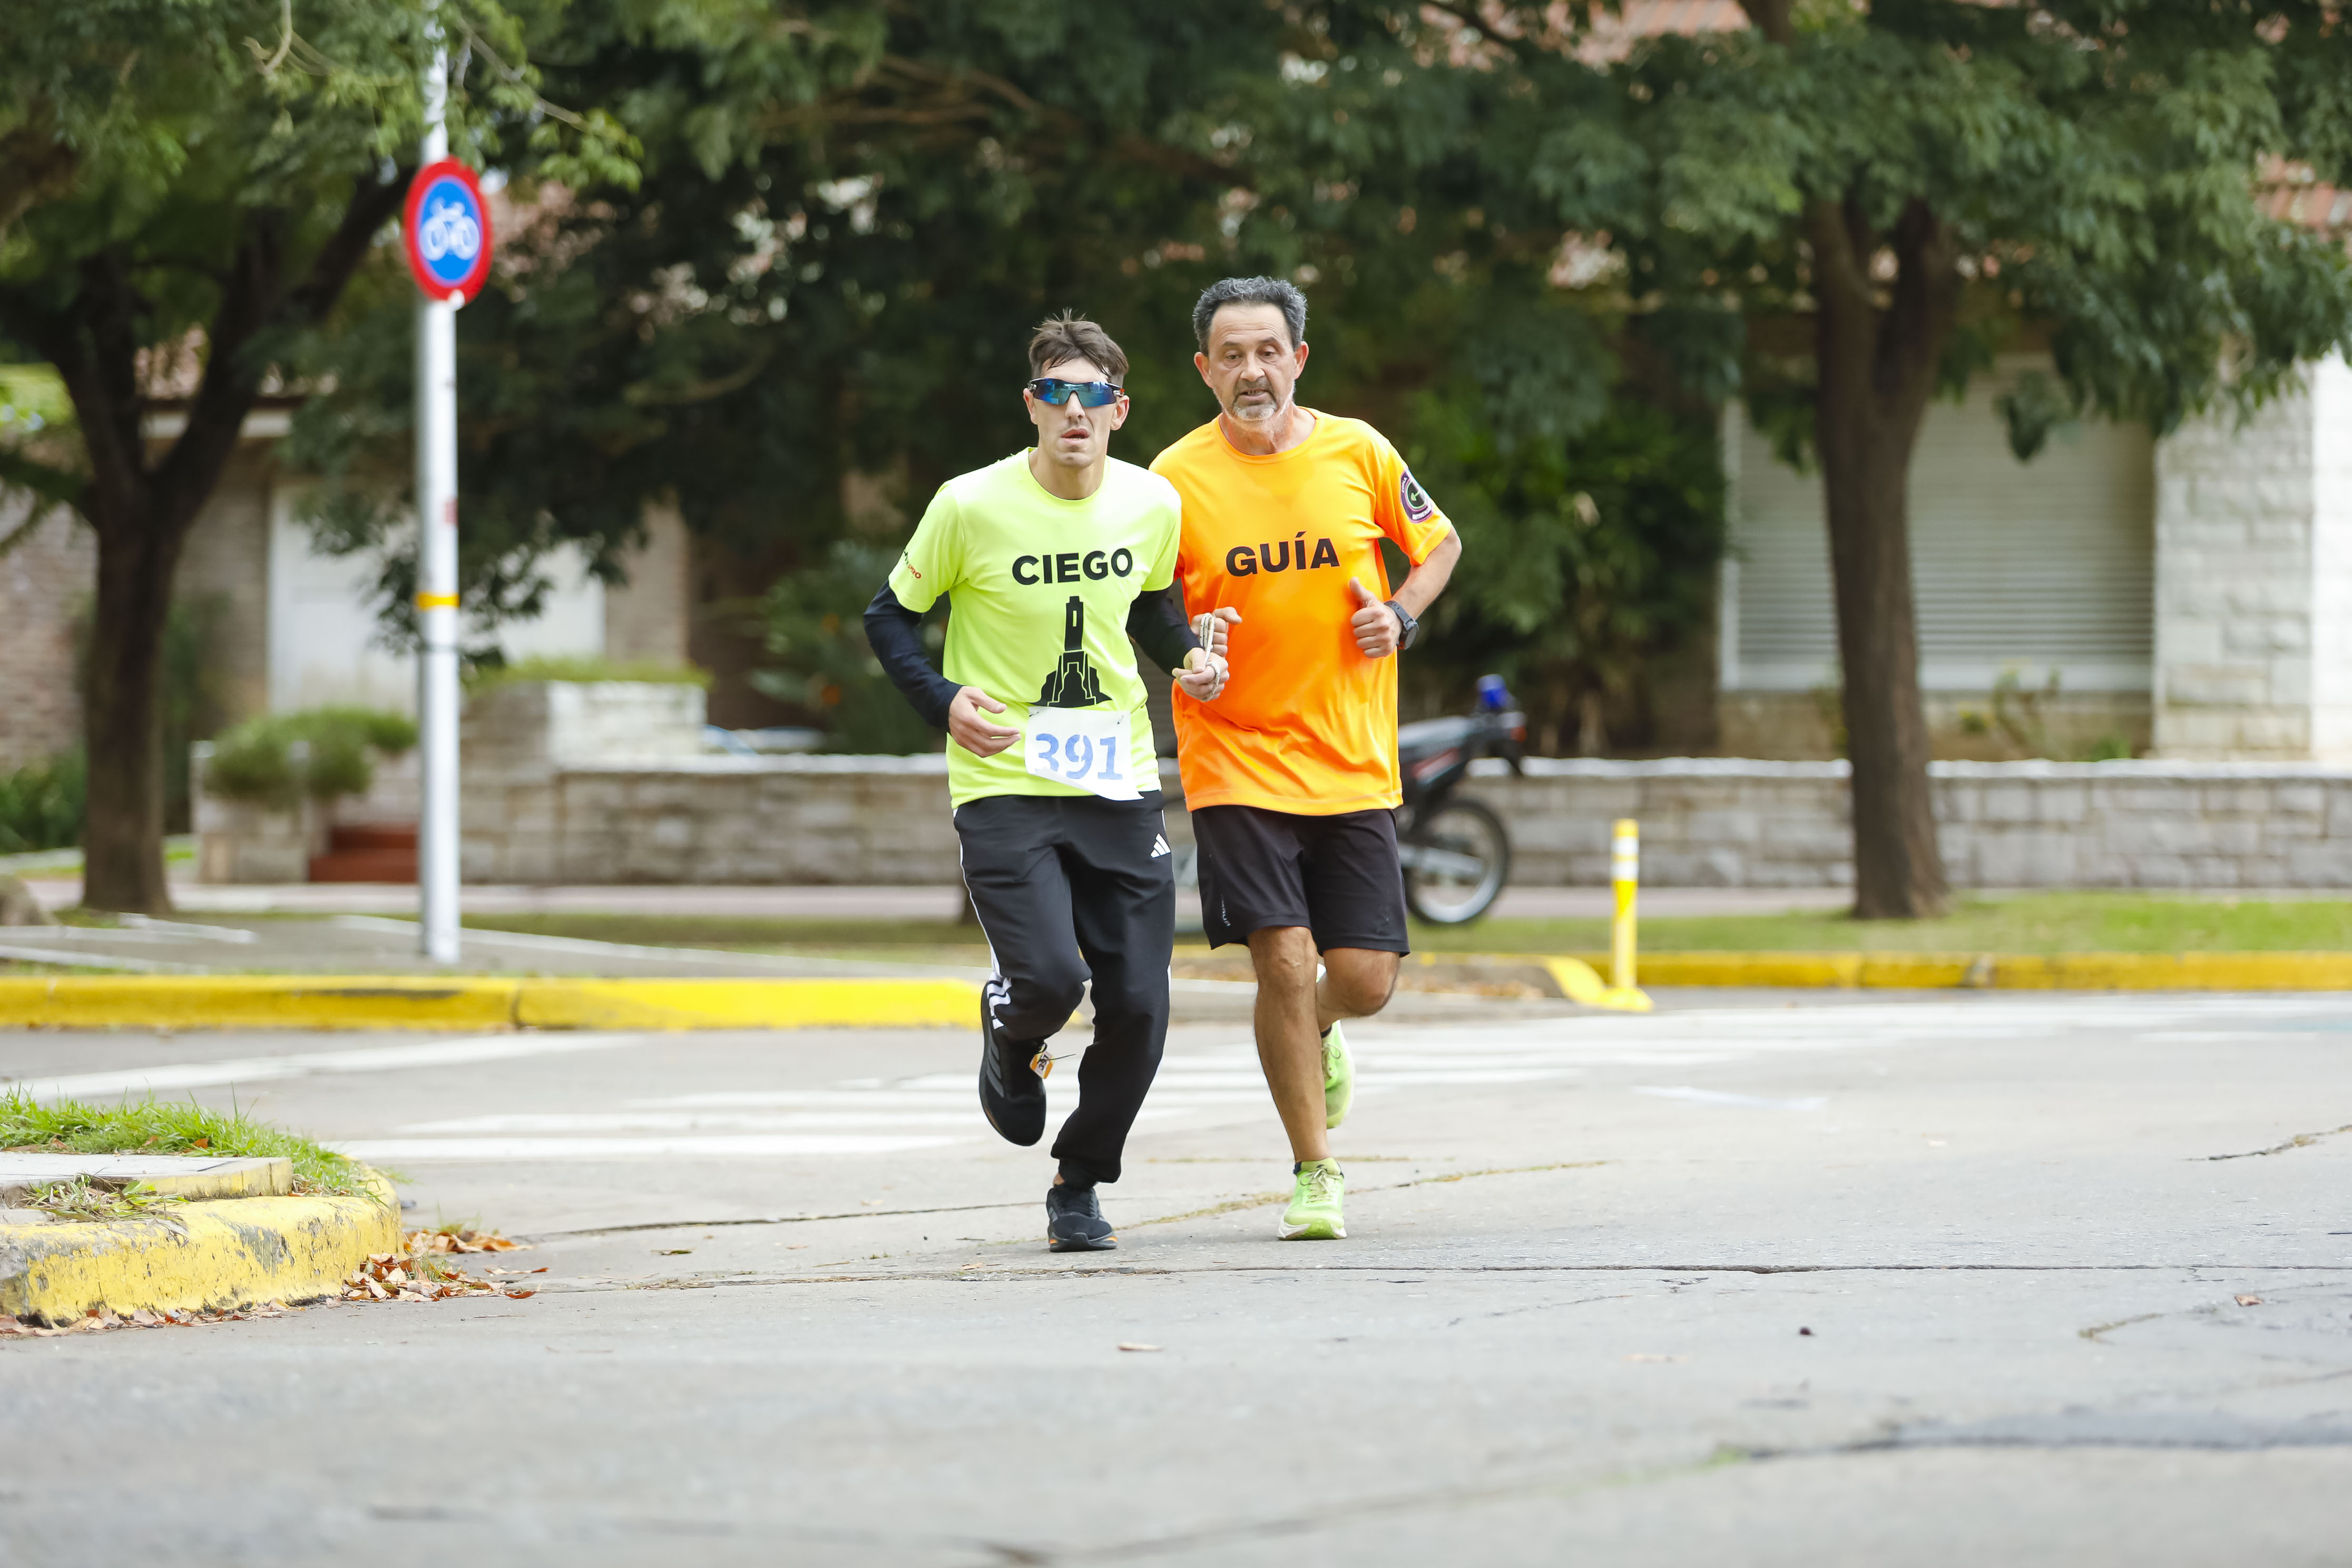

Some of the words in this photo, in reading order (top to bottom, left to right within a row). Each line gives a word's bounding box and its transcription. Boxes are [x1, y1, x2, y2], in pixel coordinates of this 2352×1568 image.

[1012, 548, 1133, 585] CIEGO
[1226, 531, 1340, 577] GUÍA
[1036, 733, 1123, 780] 391
